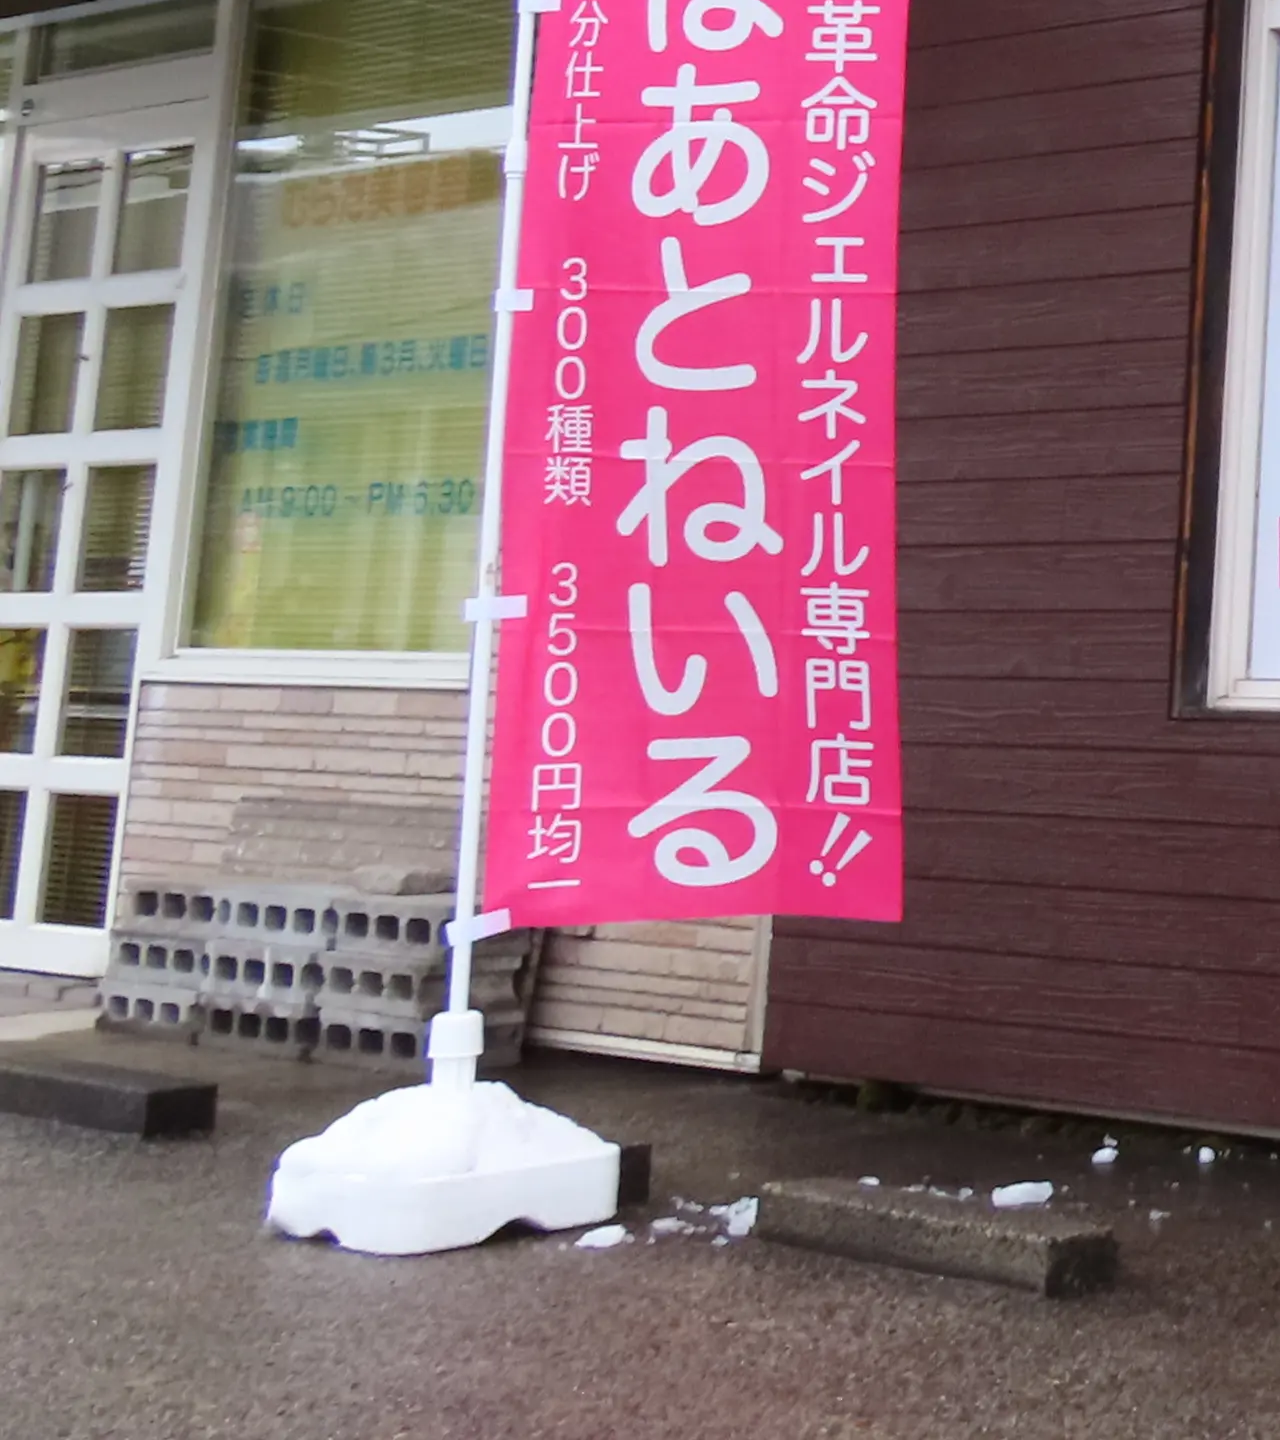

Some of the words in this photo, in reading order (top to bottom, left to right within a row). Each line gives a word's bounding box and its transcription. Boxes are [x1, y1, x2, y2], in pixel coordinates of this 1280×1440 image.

[543, 258, 594, 506] 300種類
[527, 562, 582, 890] 3500円均一
